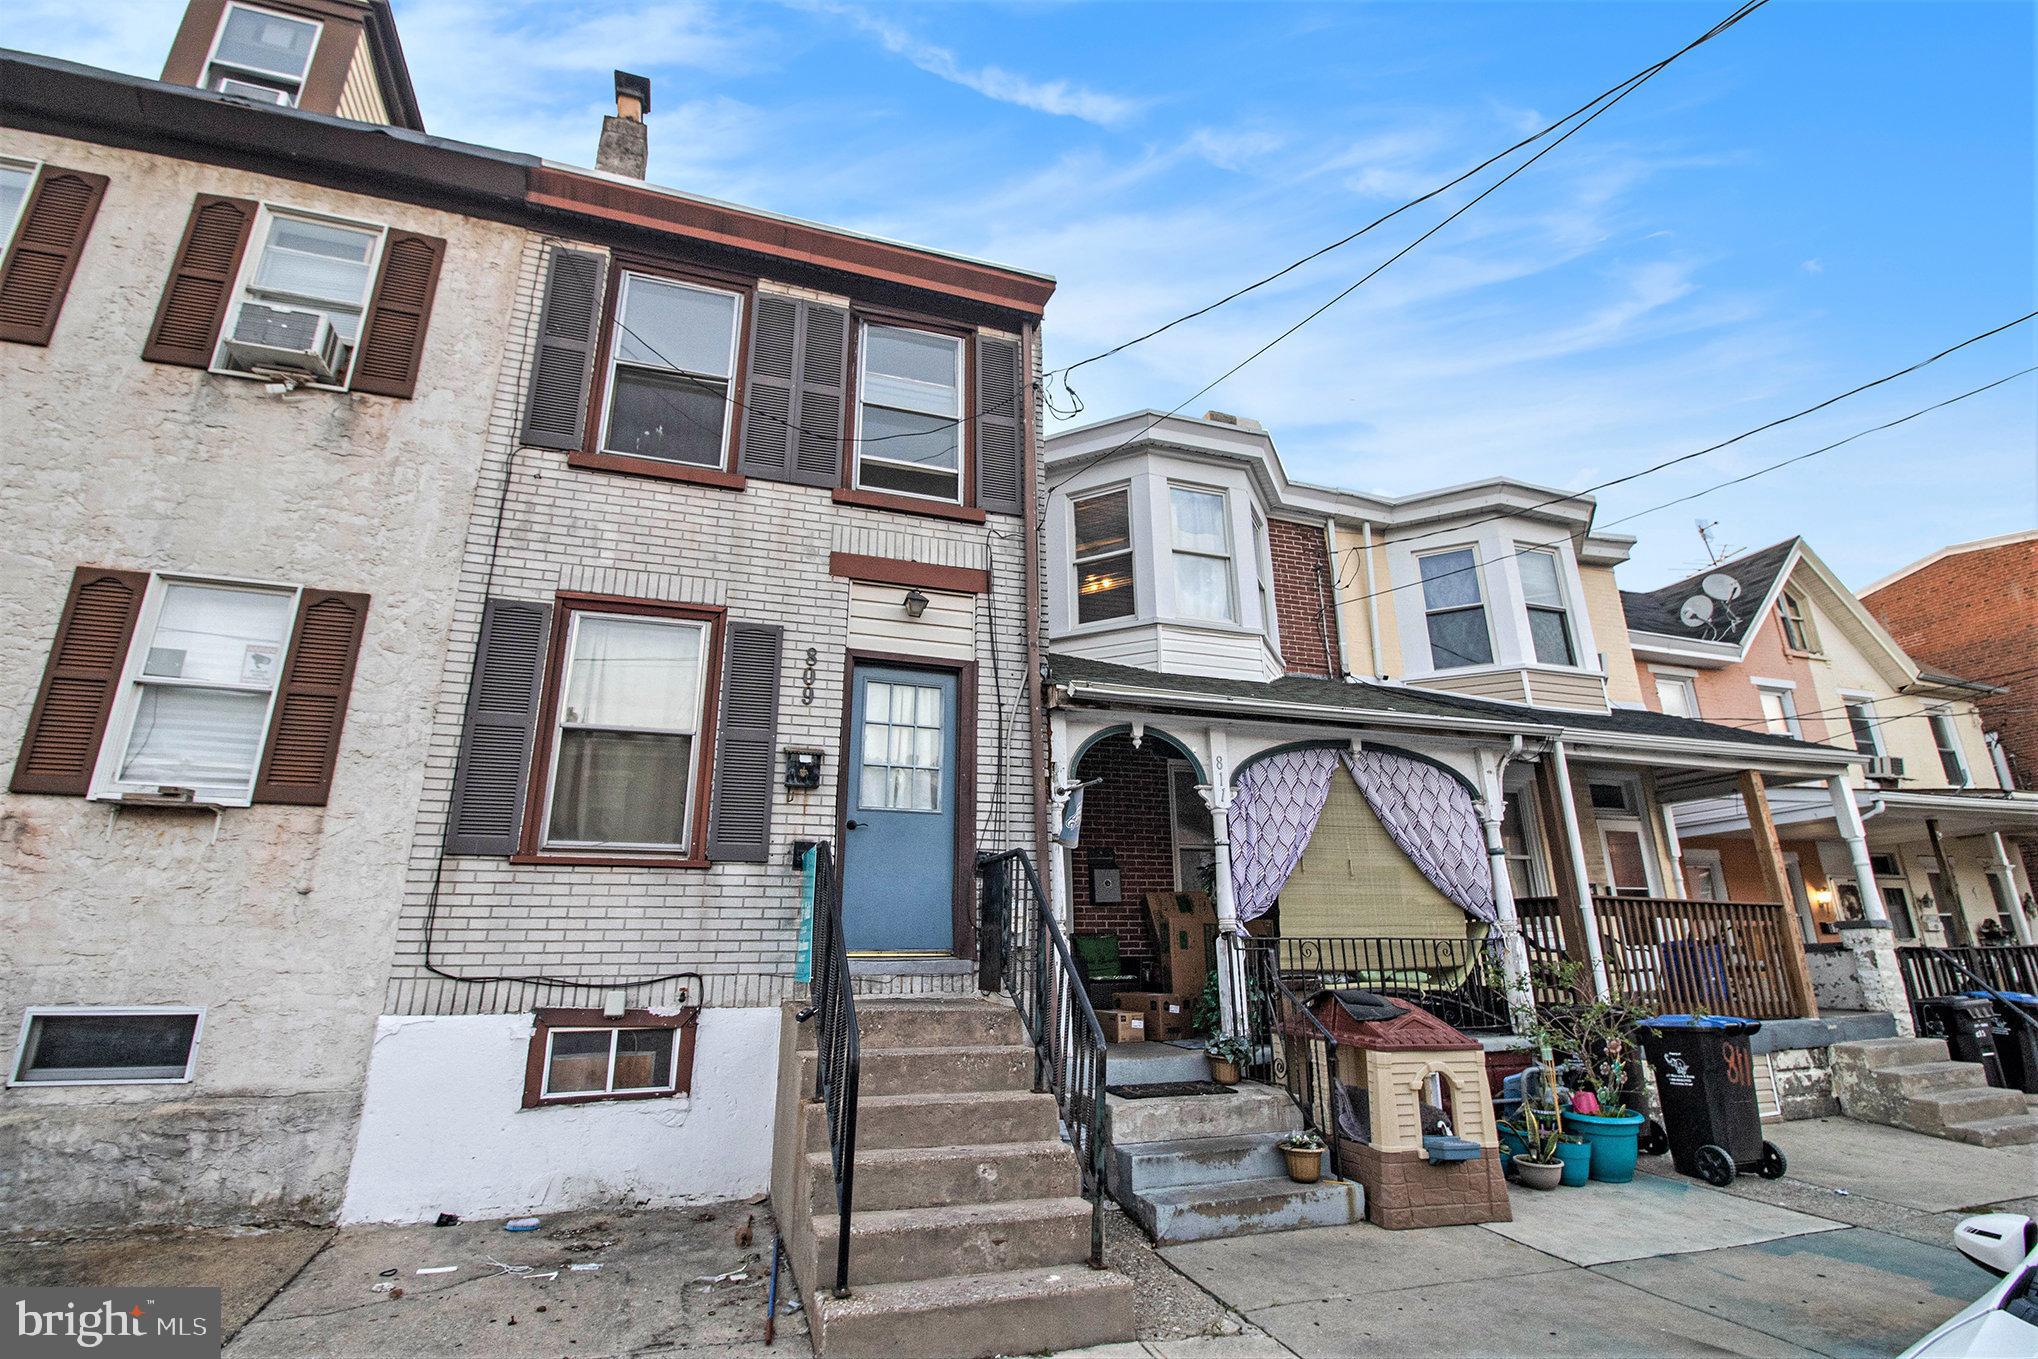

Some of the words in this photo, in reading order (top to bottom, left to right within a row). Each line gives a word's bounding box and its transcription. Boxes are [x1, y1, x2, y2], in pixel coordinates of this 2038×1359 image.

[801, 647, 817, 705] 809
[1216, 755, 1225, 802] 811
[1722, 1041, 1752, 1088] 811
